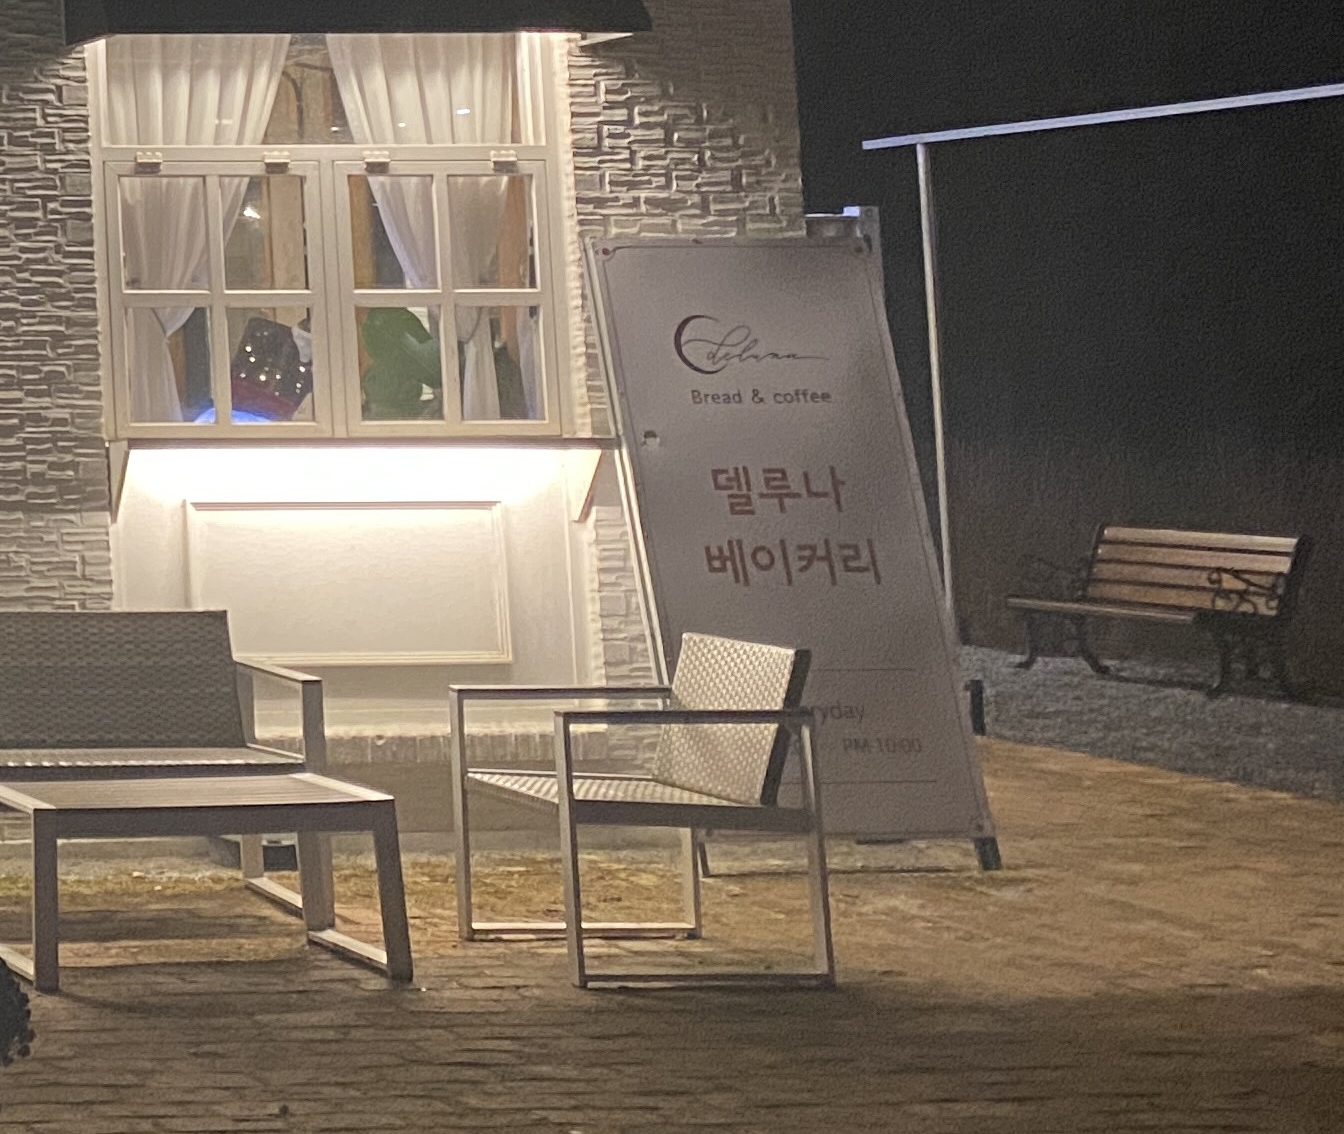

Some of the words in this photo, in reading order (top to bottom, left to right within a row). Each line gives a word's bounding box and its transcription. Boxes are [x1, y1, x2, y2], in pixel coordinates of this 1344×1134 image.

[690, 388, 743, 405] Bread
[751, 388, 765, 405] &
[773, 388, 833, 405] coffee
[711, 465, 847, 516] 델루나
[704, 537, 882, 587] 베이커리
